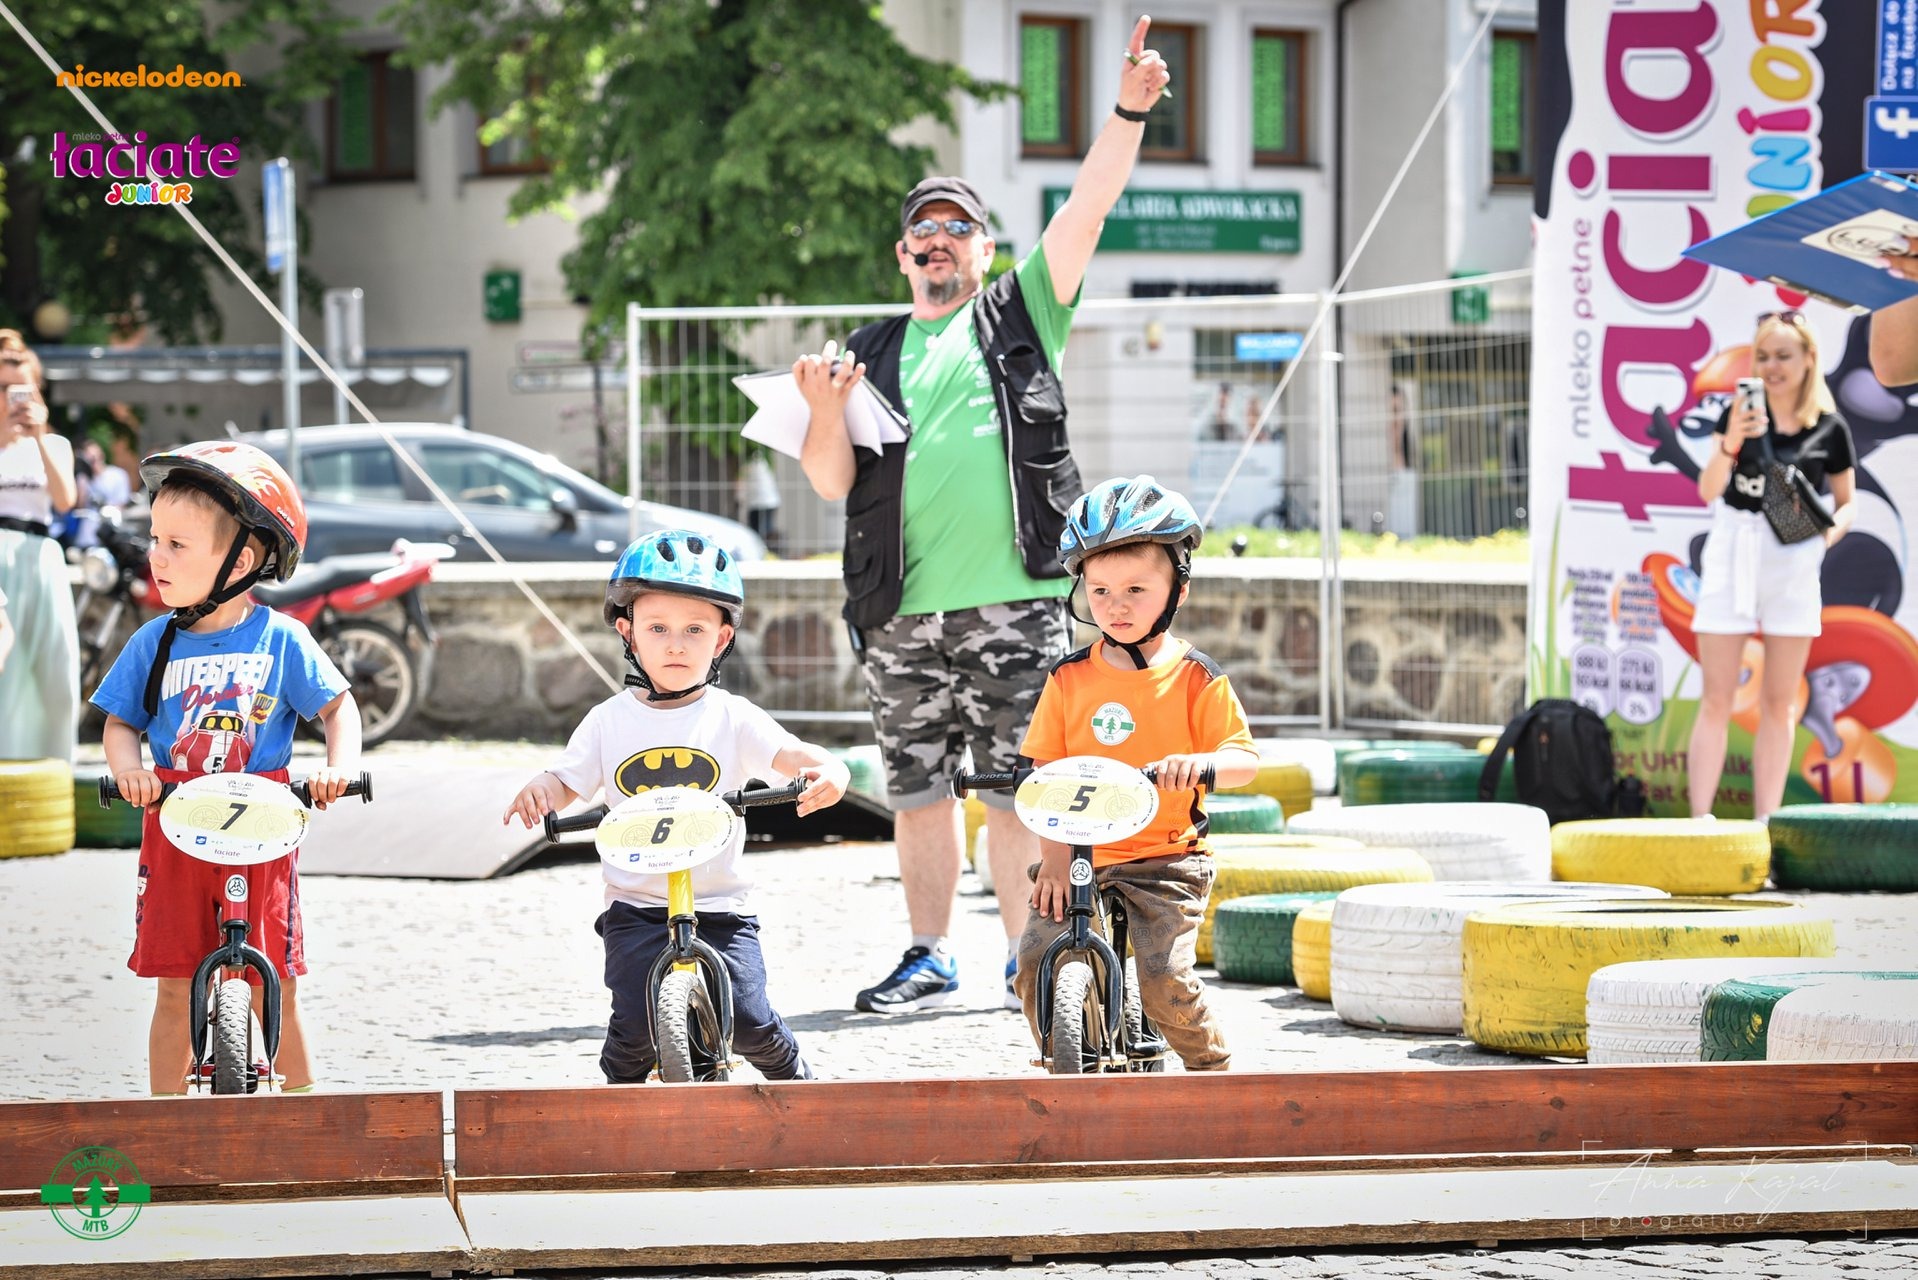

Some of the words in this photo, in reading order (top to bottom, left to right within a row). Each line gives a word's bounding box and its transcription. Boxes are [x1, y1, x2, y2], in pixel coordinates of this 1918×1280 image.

[1901, 0, 1917, 59] facebo
[1570, 217, 1594, 319] pełne
[1569, 328, 1591, 438] mleko
[219, 802, 249, 831] 7
[1068, 785, 1097, 812] 5
[650, 817, 675, 844] 6
